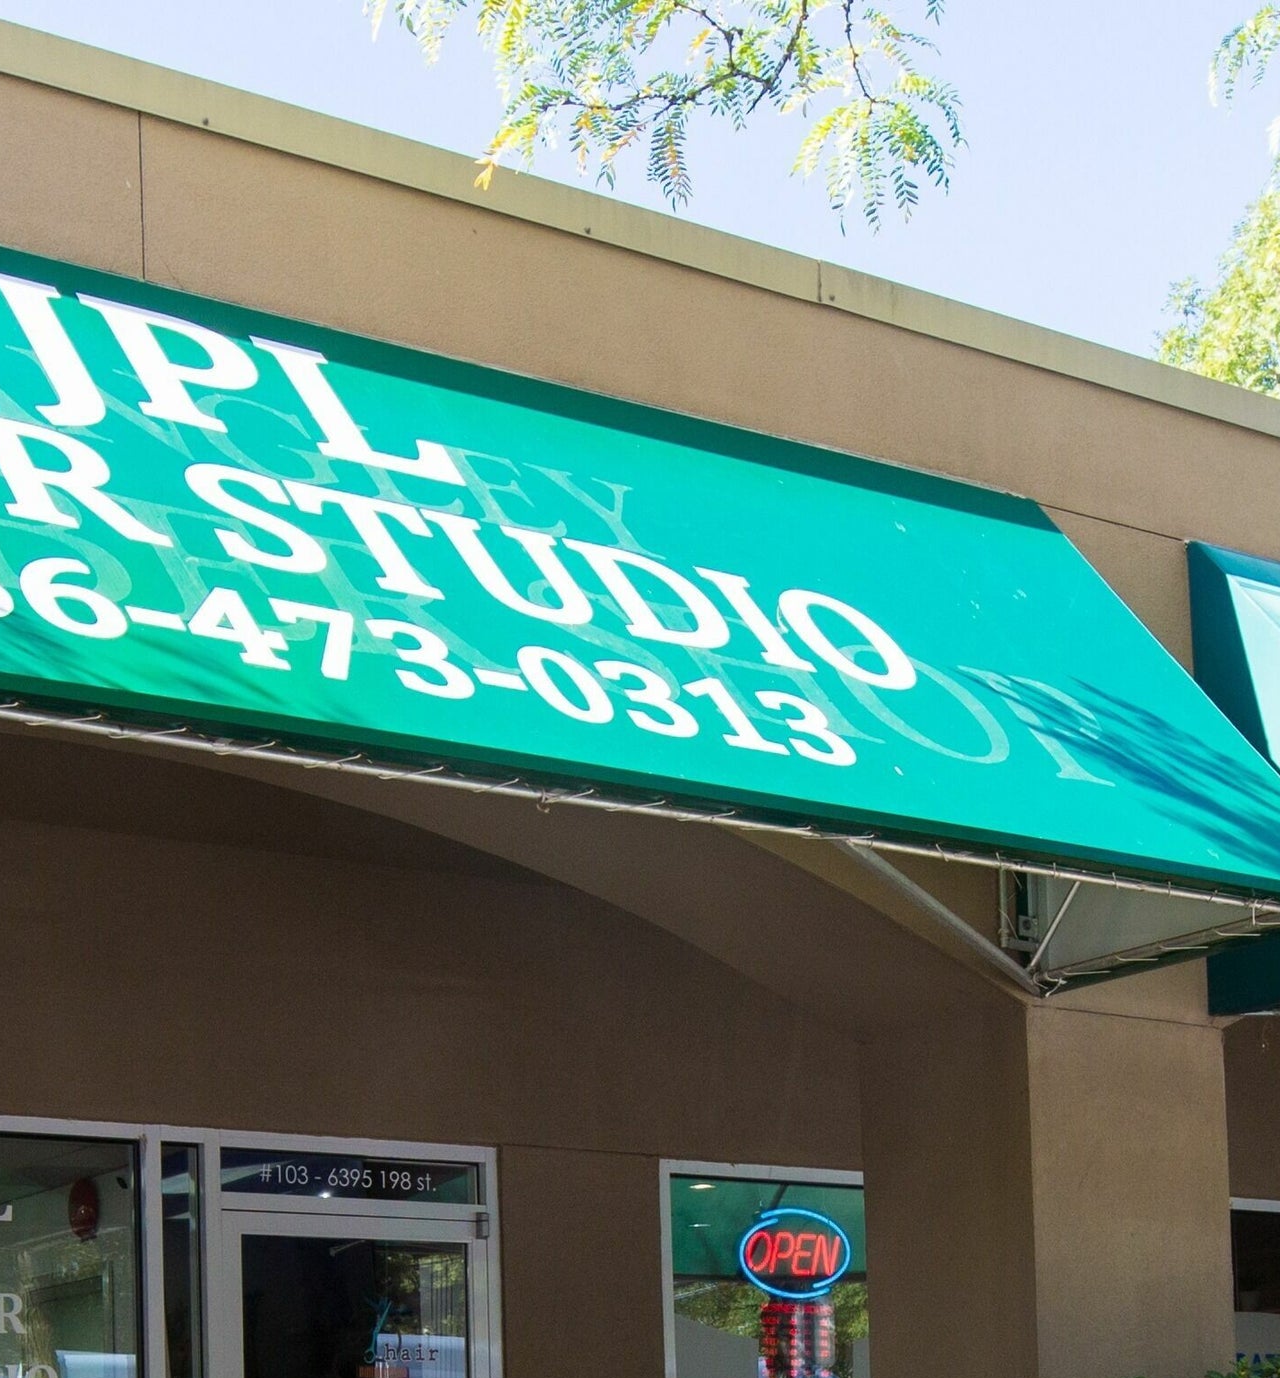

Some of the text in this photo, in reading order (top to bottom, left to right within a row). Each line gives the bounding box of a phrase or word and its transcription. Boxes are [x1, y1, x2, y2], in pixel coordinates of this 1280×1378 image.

[185, 462, 917, 691] STUDIO
[259, 1164, 309, 1186] #103
[327, 1166, 373, 1189] 6395
[379, 1169, 412, 1190] 198
[416, 1173, 437, 1192] st.
[745, 1229, 841, 1277] OPEN
[384, 1343, 439, 1361] hair
